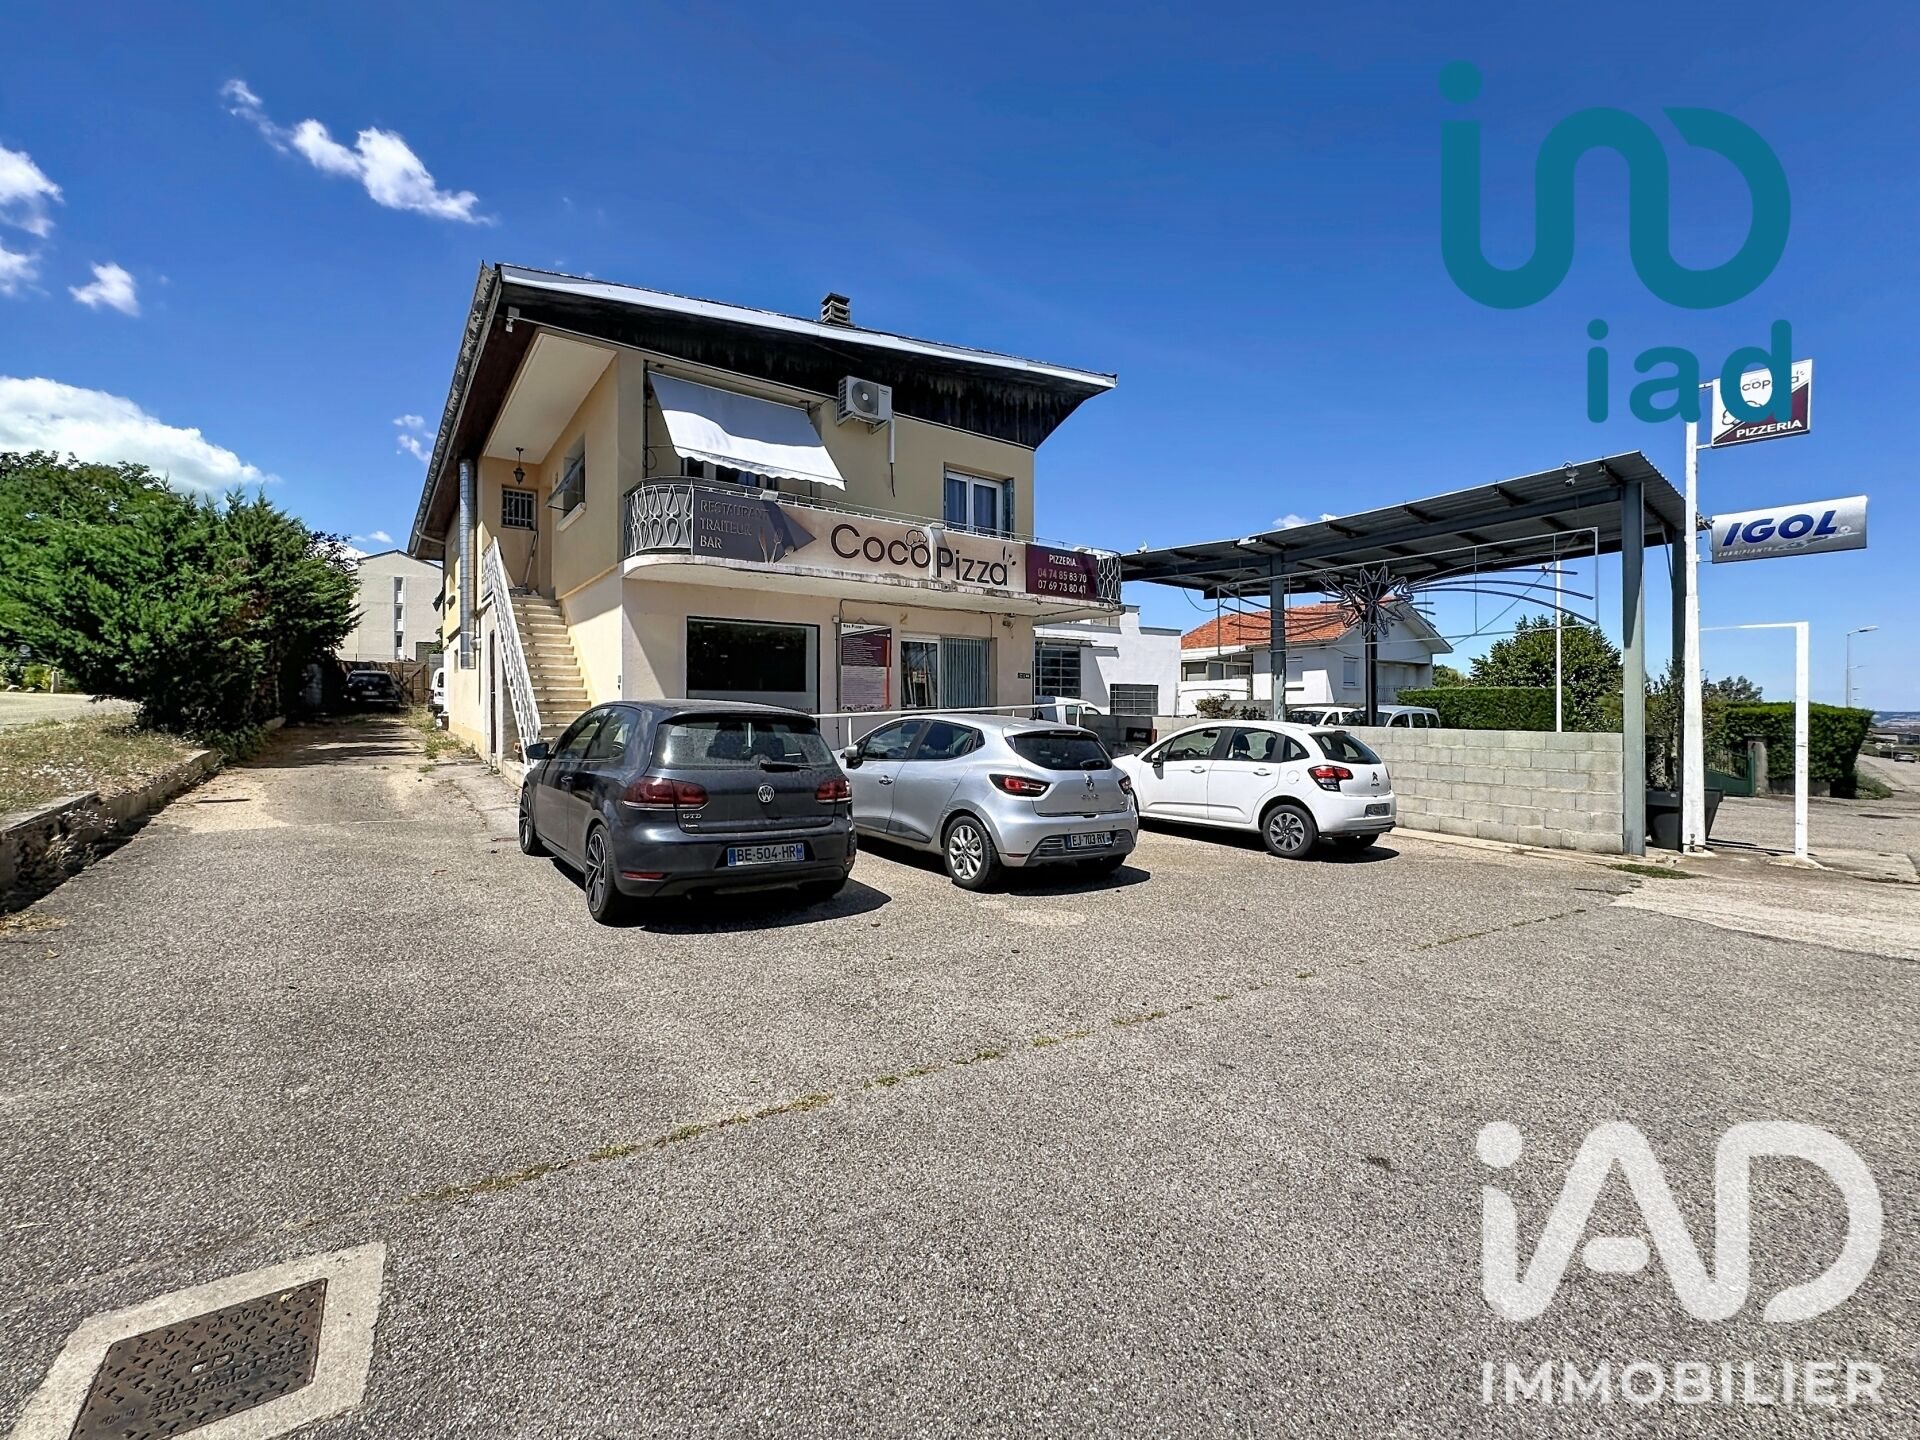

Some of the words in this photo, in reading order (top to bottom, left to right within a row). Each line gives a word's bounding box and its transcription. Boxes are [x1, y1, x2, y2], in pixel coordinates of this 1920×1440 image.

[1736, 419, 1803, 438] PIZZERIA
[700, 517, 752, 537] TRAITEUR
[1722, 509, 1838, 547] IGOL
[700, 535, 723, 550] BAR
[1048, 554, 1077, 567] PIZZERIA
[1037, 567, 1047, 578] 04
[1048, 569, 1058, 580] 74
[1058, 570, 1068, 581] 85
[1068, 572, 1078, 582] 83
[1078, 573, 1087, 583] 70
[1037, 579, 1047, 590] 07
[1048, 581, 1058, 591] 69
[1059, 582, 1068, 592] 73
[1068, 583, 1078, 593] 80
[1078, 584, 1087, 594] 41
